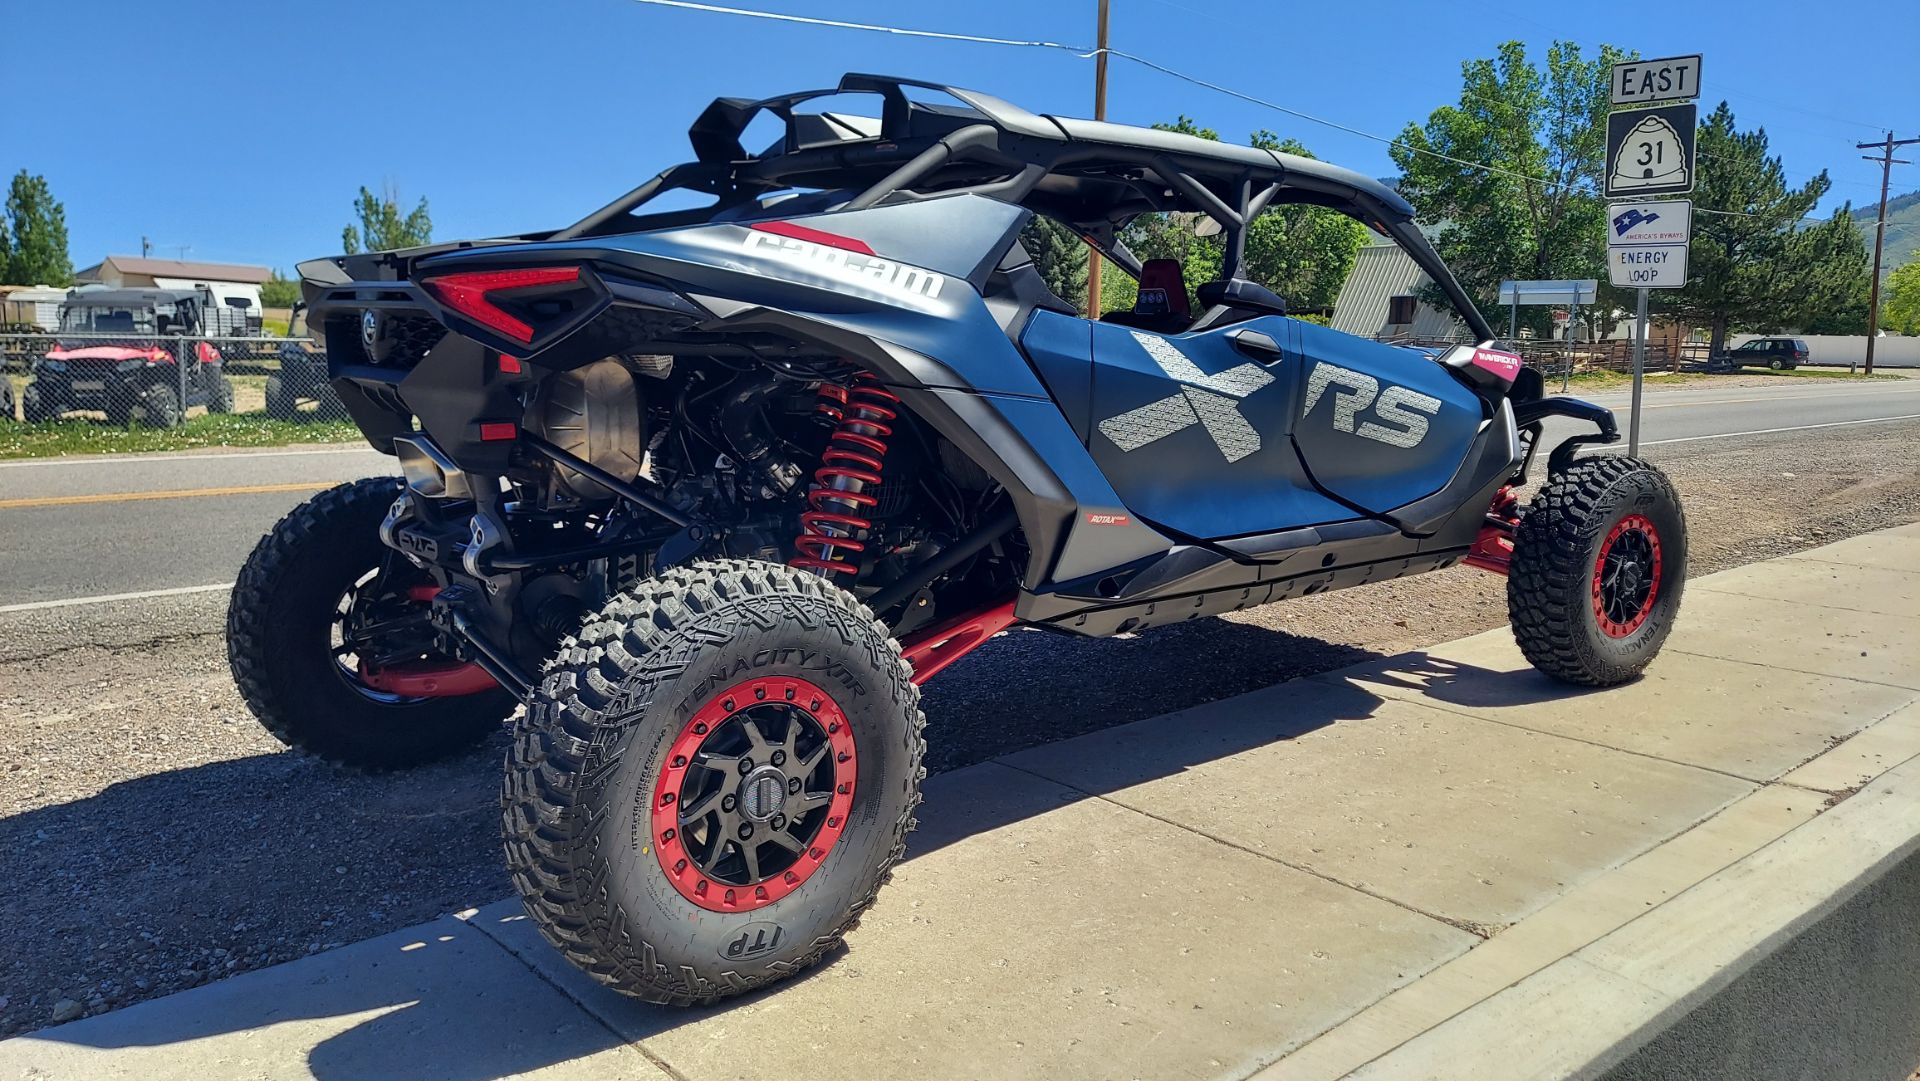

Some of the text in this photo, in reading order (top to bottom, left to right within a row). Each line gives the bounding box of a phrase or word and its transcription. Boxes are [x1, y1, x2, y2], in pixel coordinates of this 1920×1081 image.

[1621, 66, 1688, 96] EAST
[1637, 141, 1663, 166] 31
[1621, 251, 1669, 264] ENERGY
[1628, 269, 1659, 282] LOOP
[1098, 331, 1442, 464] X RS
[1090, 514, 1116, 524] ROTAX
[674, 647, 817, 717] TENACITY
[727, 925, 783, 956] ITP
